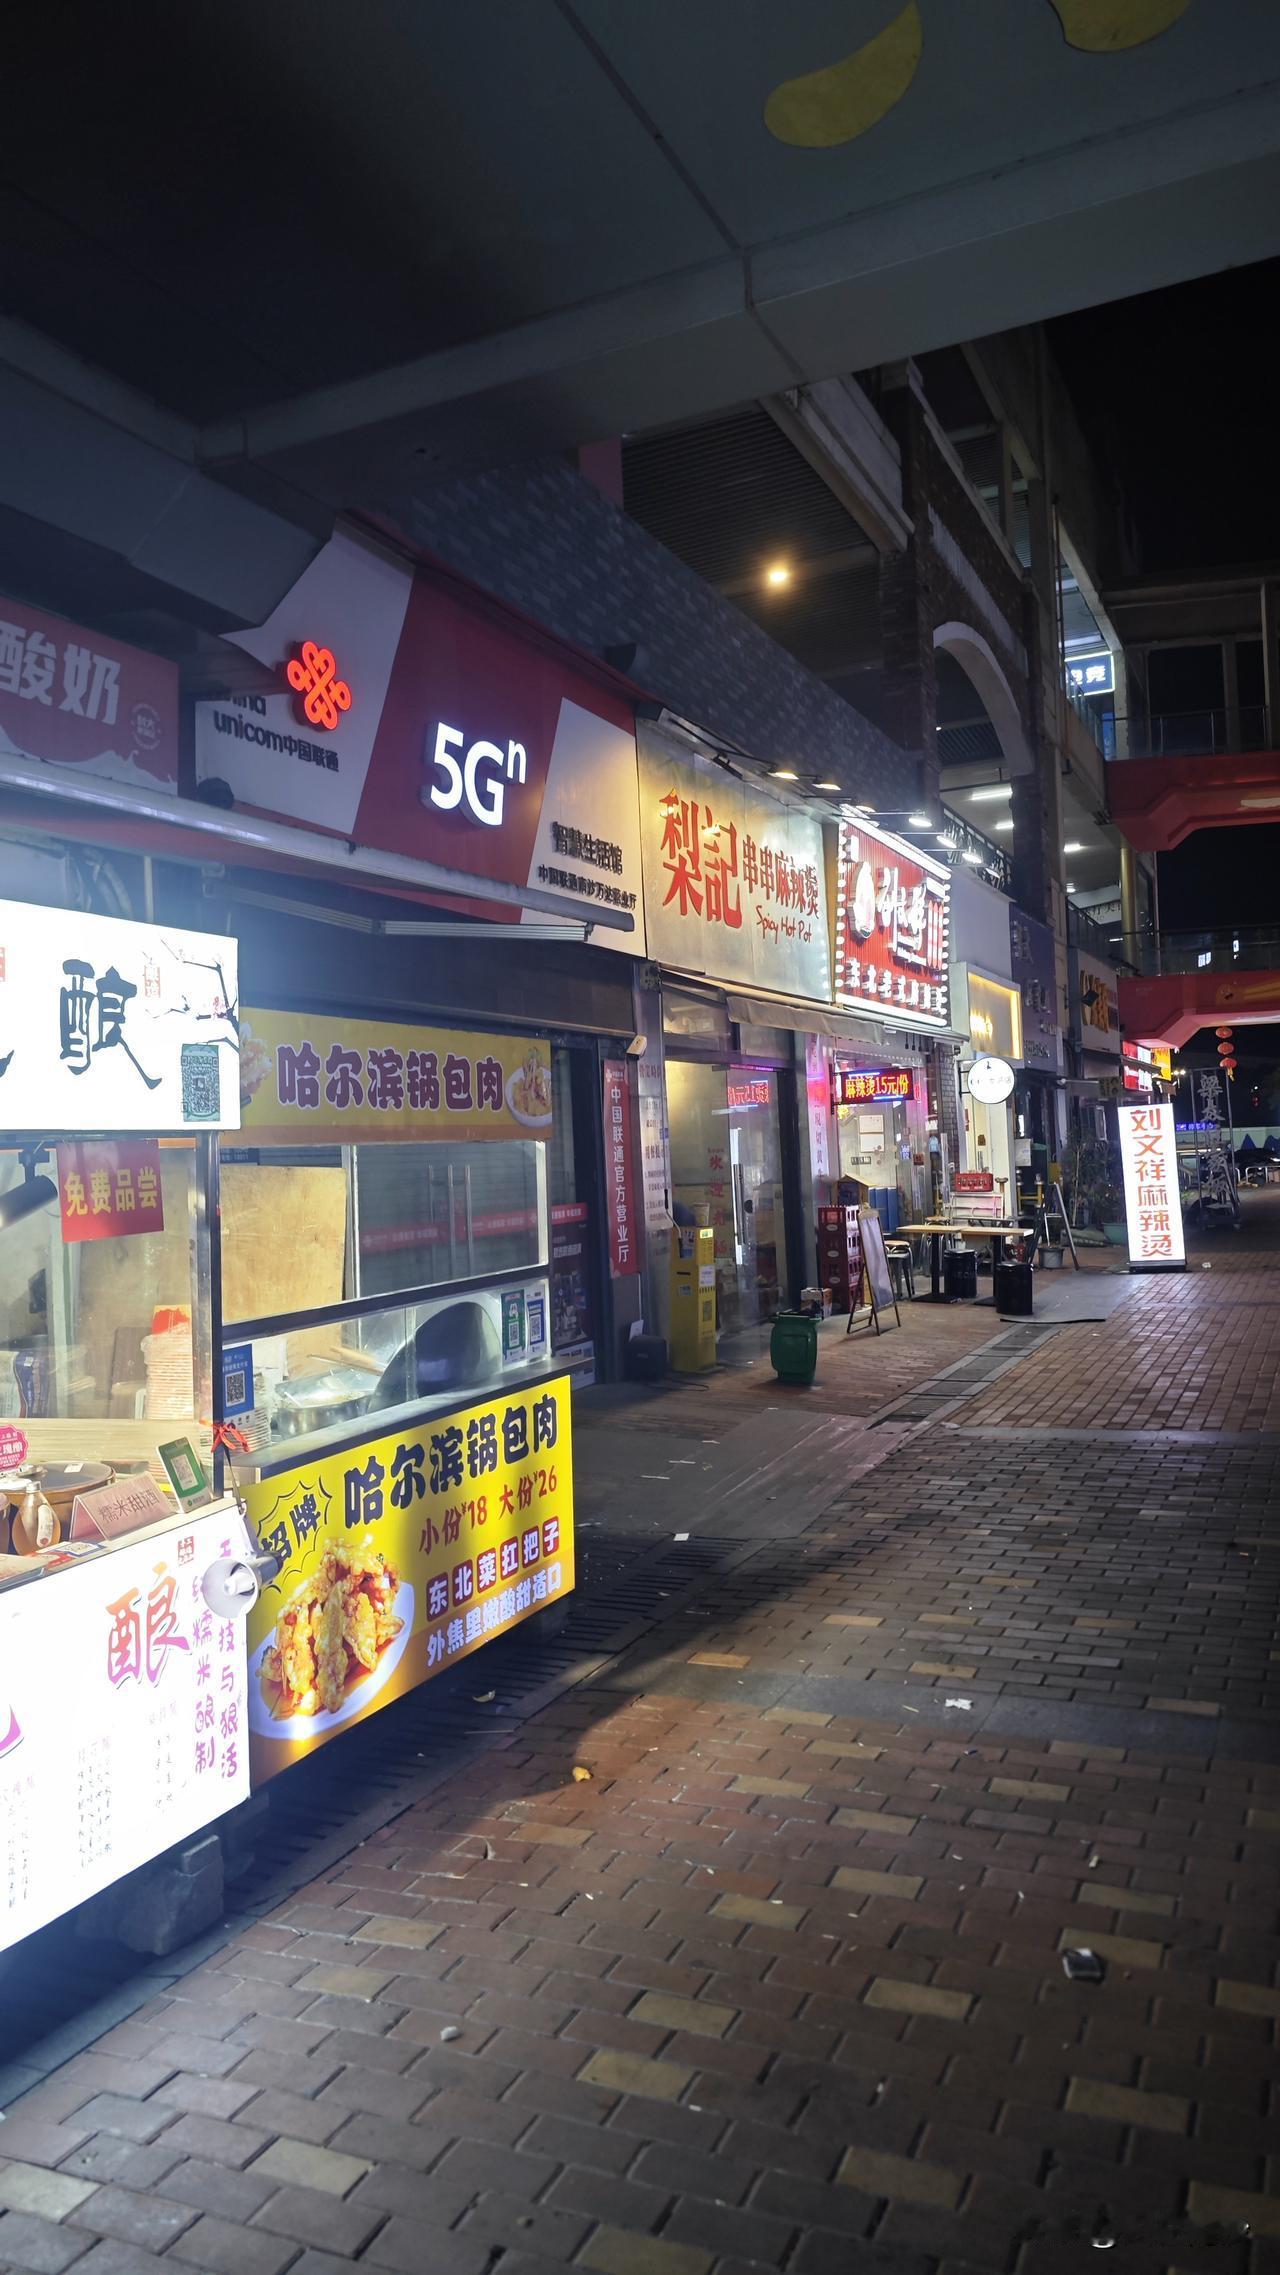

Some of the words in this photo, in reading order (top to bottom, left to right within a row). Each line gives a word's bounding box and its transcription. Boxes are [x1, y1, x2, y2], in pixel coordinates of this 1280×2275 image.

[0, 620, 120, 726] 酸奶
[213, 710, 284, 753] unicom
[282, 735, 340, 773] 中国联通
[550, 821, 624, 876] 智慧生活馆
[756, 904, 778, 945] Spicy
[780, 915, 796, 938] Hot
[798, 920, 812, 943] Pot
[277, 1041, 505, 1112] 哈尔滨锅包肉
[845, 1073, 909, 1099] 麻辣烫15元/份
[64, 1166, 158, 1217] 免费品尝
[611, 1086, 630, 1264] 中国联通官方营业厅
[1130, 1108, 1173, 1257] 刘文祥麻辣烫
[343, 1394, 558, 1529] 哈尔滨锅包肉
[98, 1488, 160, 1524] 糯米甜酒
[260, 1494, 321, 1563] 招牌
[428, 1521, 560, 1616] 东北菜扛把子
[426, 1561, 562, 1668] 外焦里嫩酸甜适口
